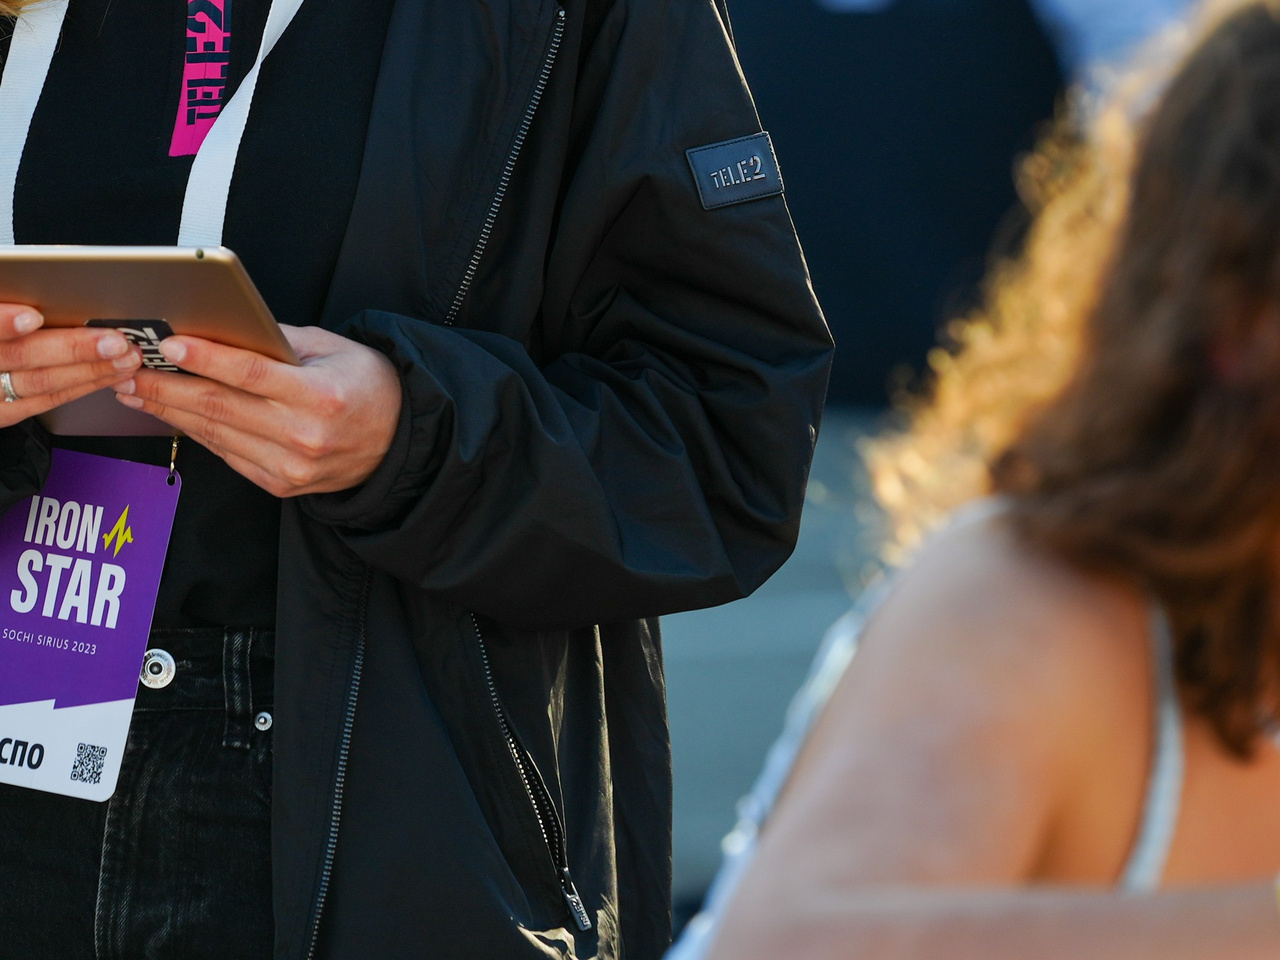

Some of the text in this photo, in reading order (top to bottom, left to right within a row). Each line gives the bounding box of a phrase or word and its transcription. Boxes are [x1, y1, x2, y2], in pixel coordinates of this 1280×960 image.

[710, 155, 766, 189] TELE2
[23, 495, 104, 554] IRON
[10, 549, 126, 629] STAR
[2, 628, 97, 655] SOCHI SIRIUS 2023
